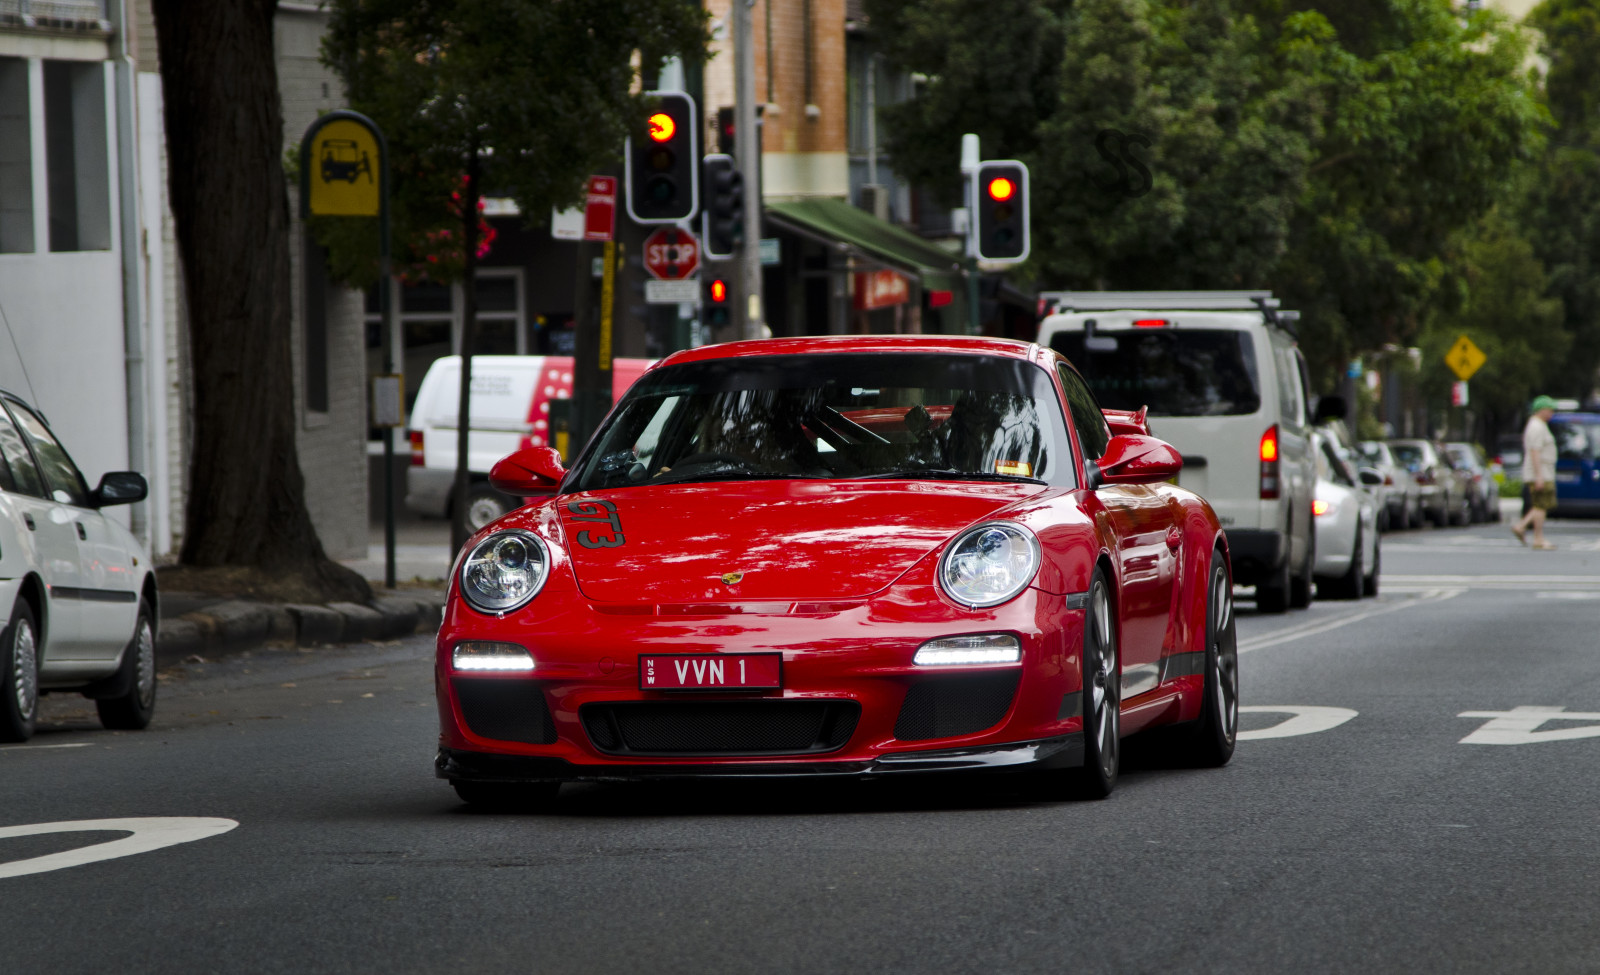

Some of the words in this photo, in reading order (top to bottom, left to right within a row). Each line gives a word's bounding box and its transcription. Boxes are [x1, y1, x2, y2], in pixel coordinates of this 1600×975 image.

[649, 244, 694, 265] STOP
[567, 499, 626, 549] GT3
[647, 659, 655, 684] NSW
[674, 659, 724, 685] VVN
[739, 659, 746, 684] 1
